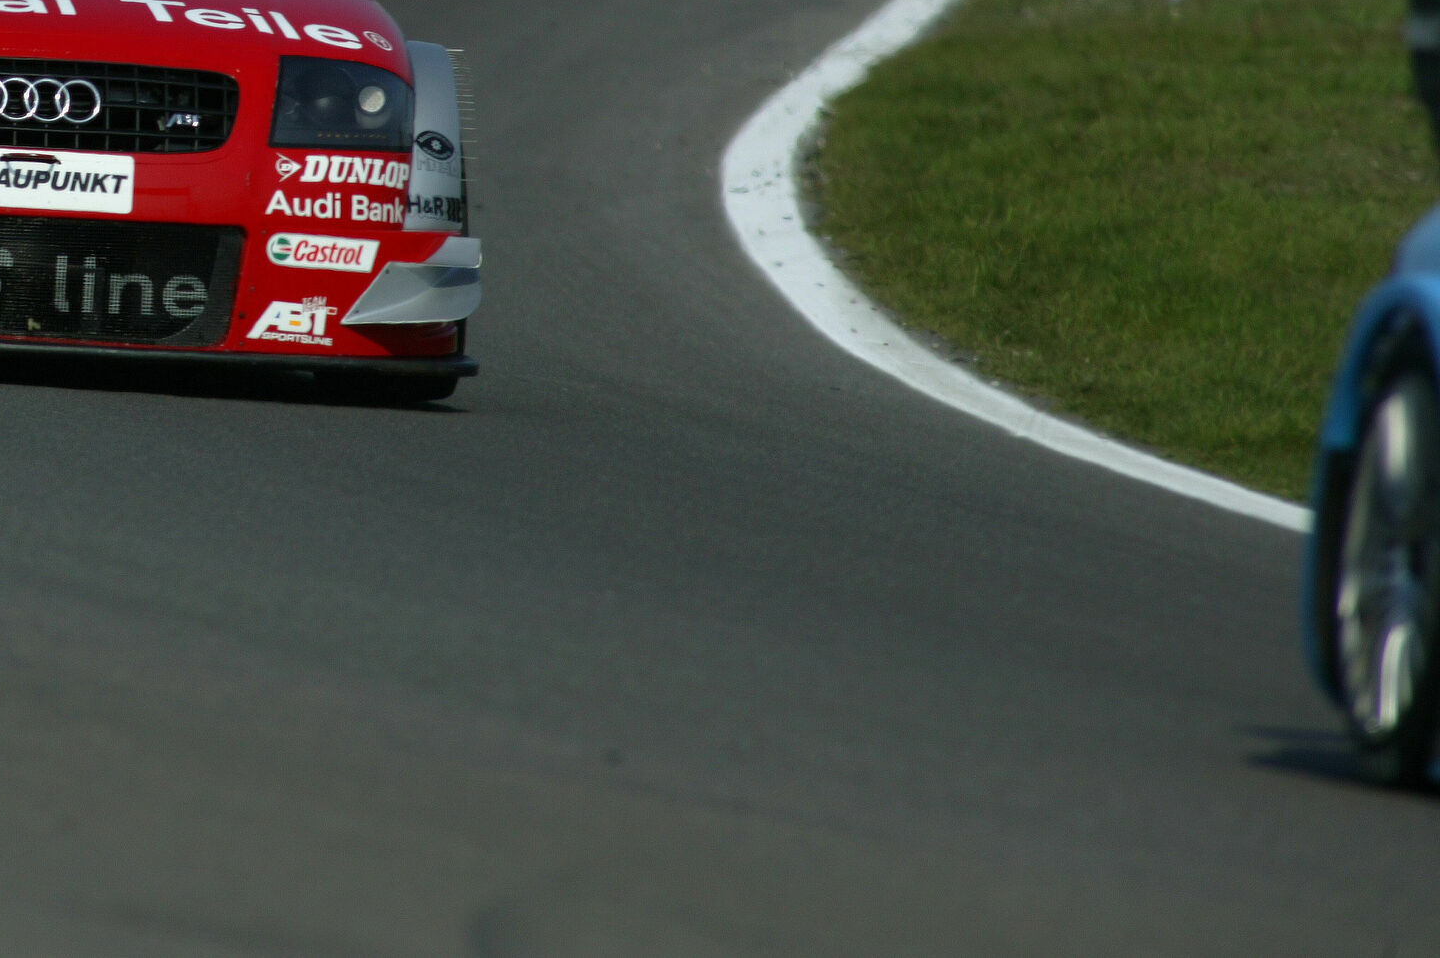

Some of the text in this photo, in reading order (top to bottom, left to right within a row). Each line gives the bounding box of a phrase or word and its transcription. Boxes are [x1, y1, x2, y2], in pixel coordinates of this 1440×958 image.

[299, 154, 410, 190] DUNLOP
[264, 189, 405, 224] Audi Bank
[293, 239, 365, 266] Castrol
[54, 254, 209, 318] line
[246, 301, 328, 339] ABT
[261, 331, 333, 346] SPORTSLINE
